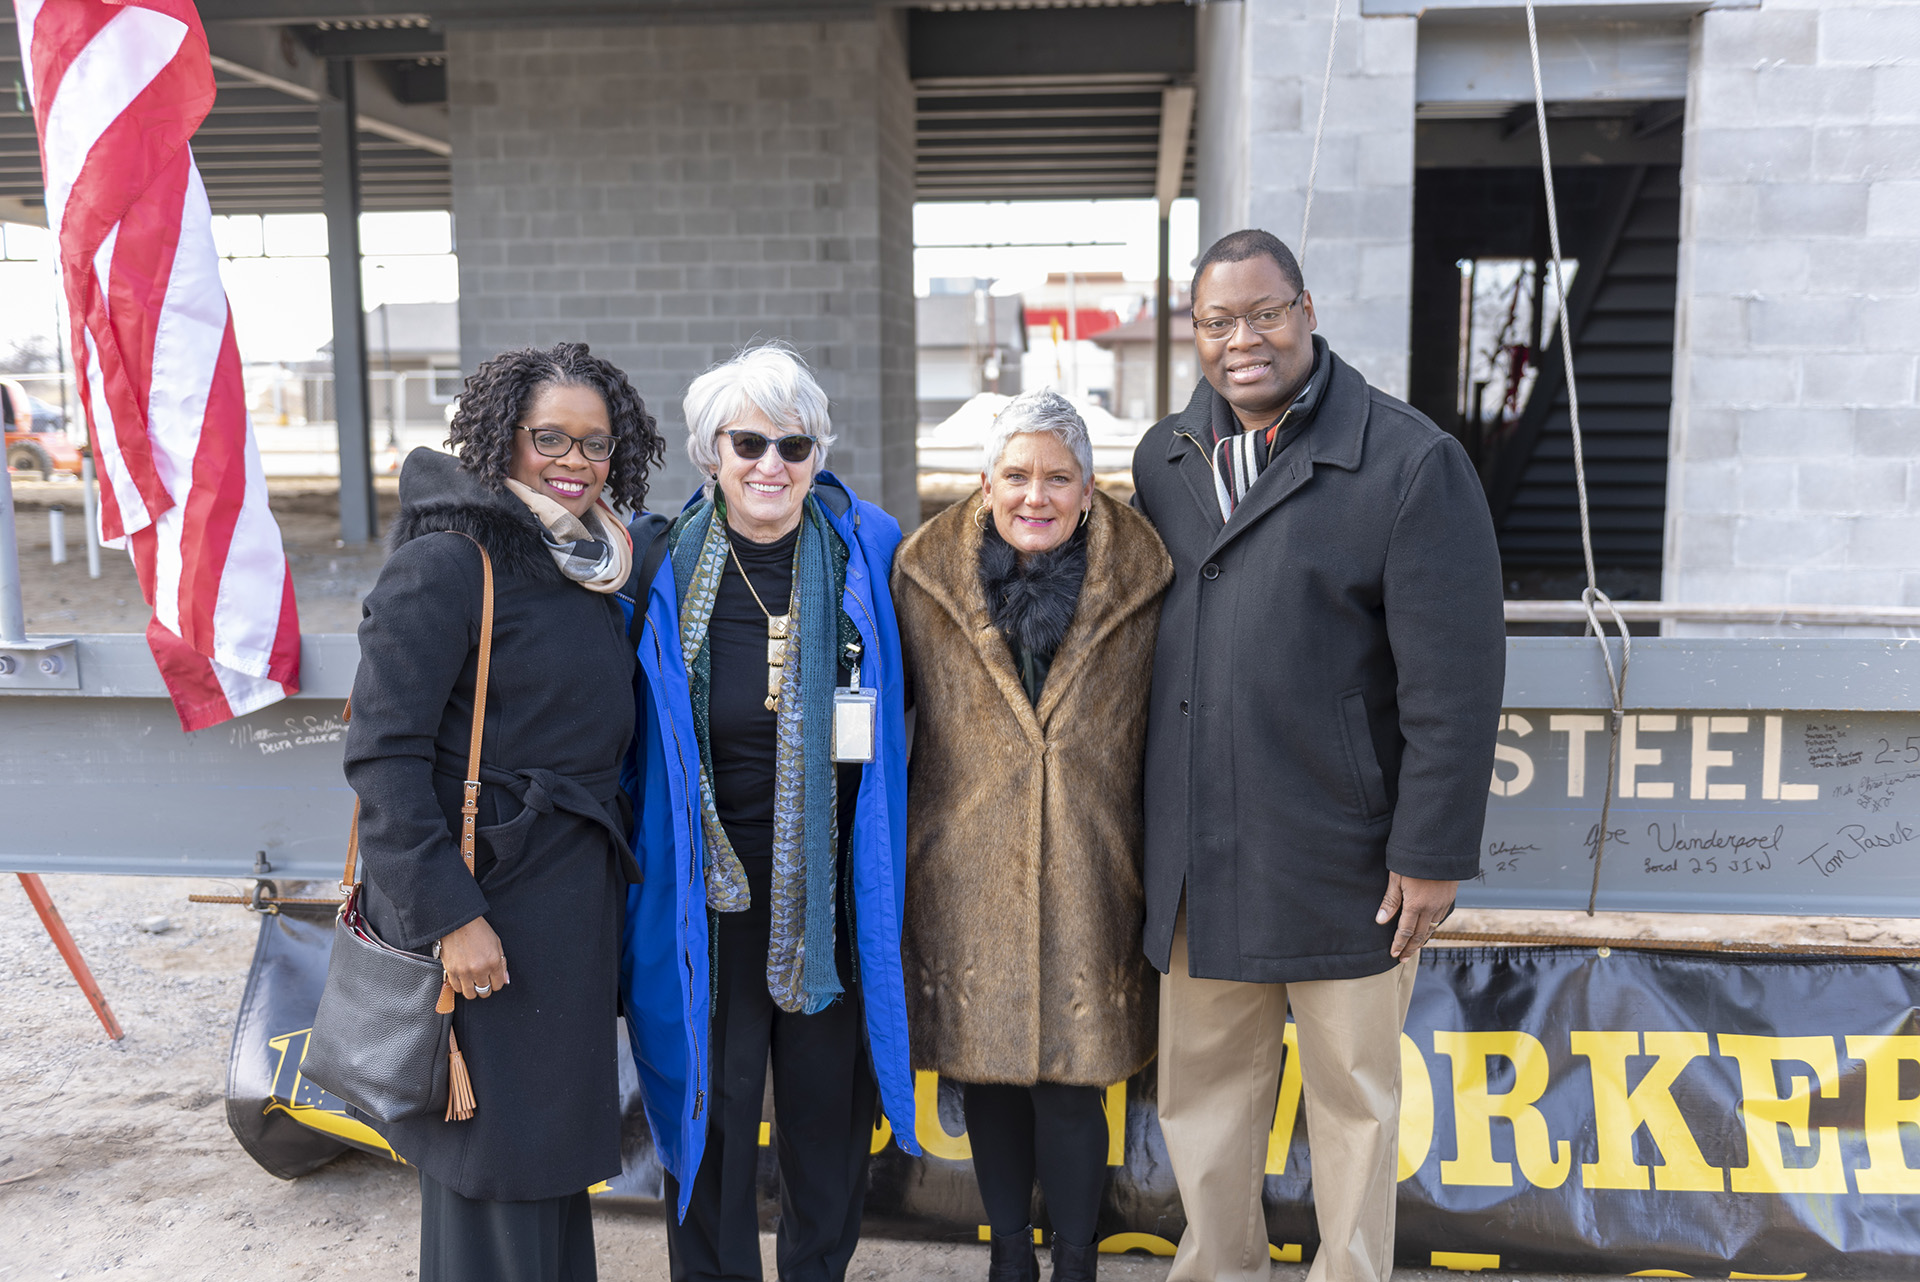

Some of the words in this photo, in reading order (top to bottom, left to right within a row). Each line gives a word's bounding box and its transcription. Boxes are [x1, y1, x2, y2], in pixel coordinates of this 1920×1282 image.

[258, 739, 293, 756] DELTA
[295, 731, 342, 746] COLLEGE
[1490, 714, 1820, 800] STEEL
[1644, 857, 1678, 874] Local
[1688, 856, 1718, 874] 25
